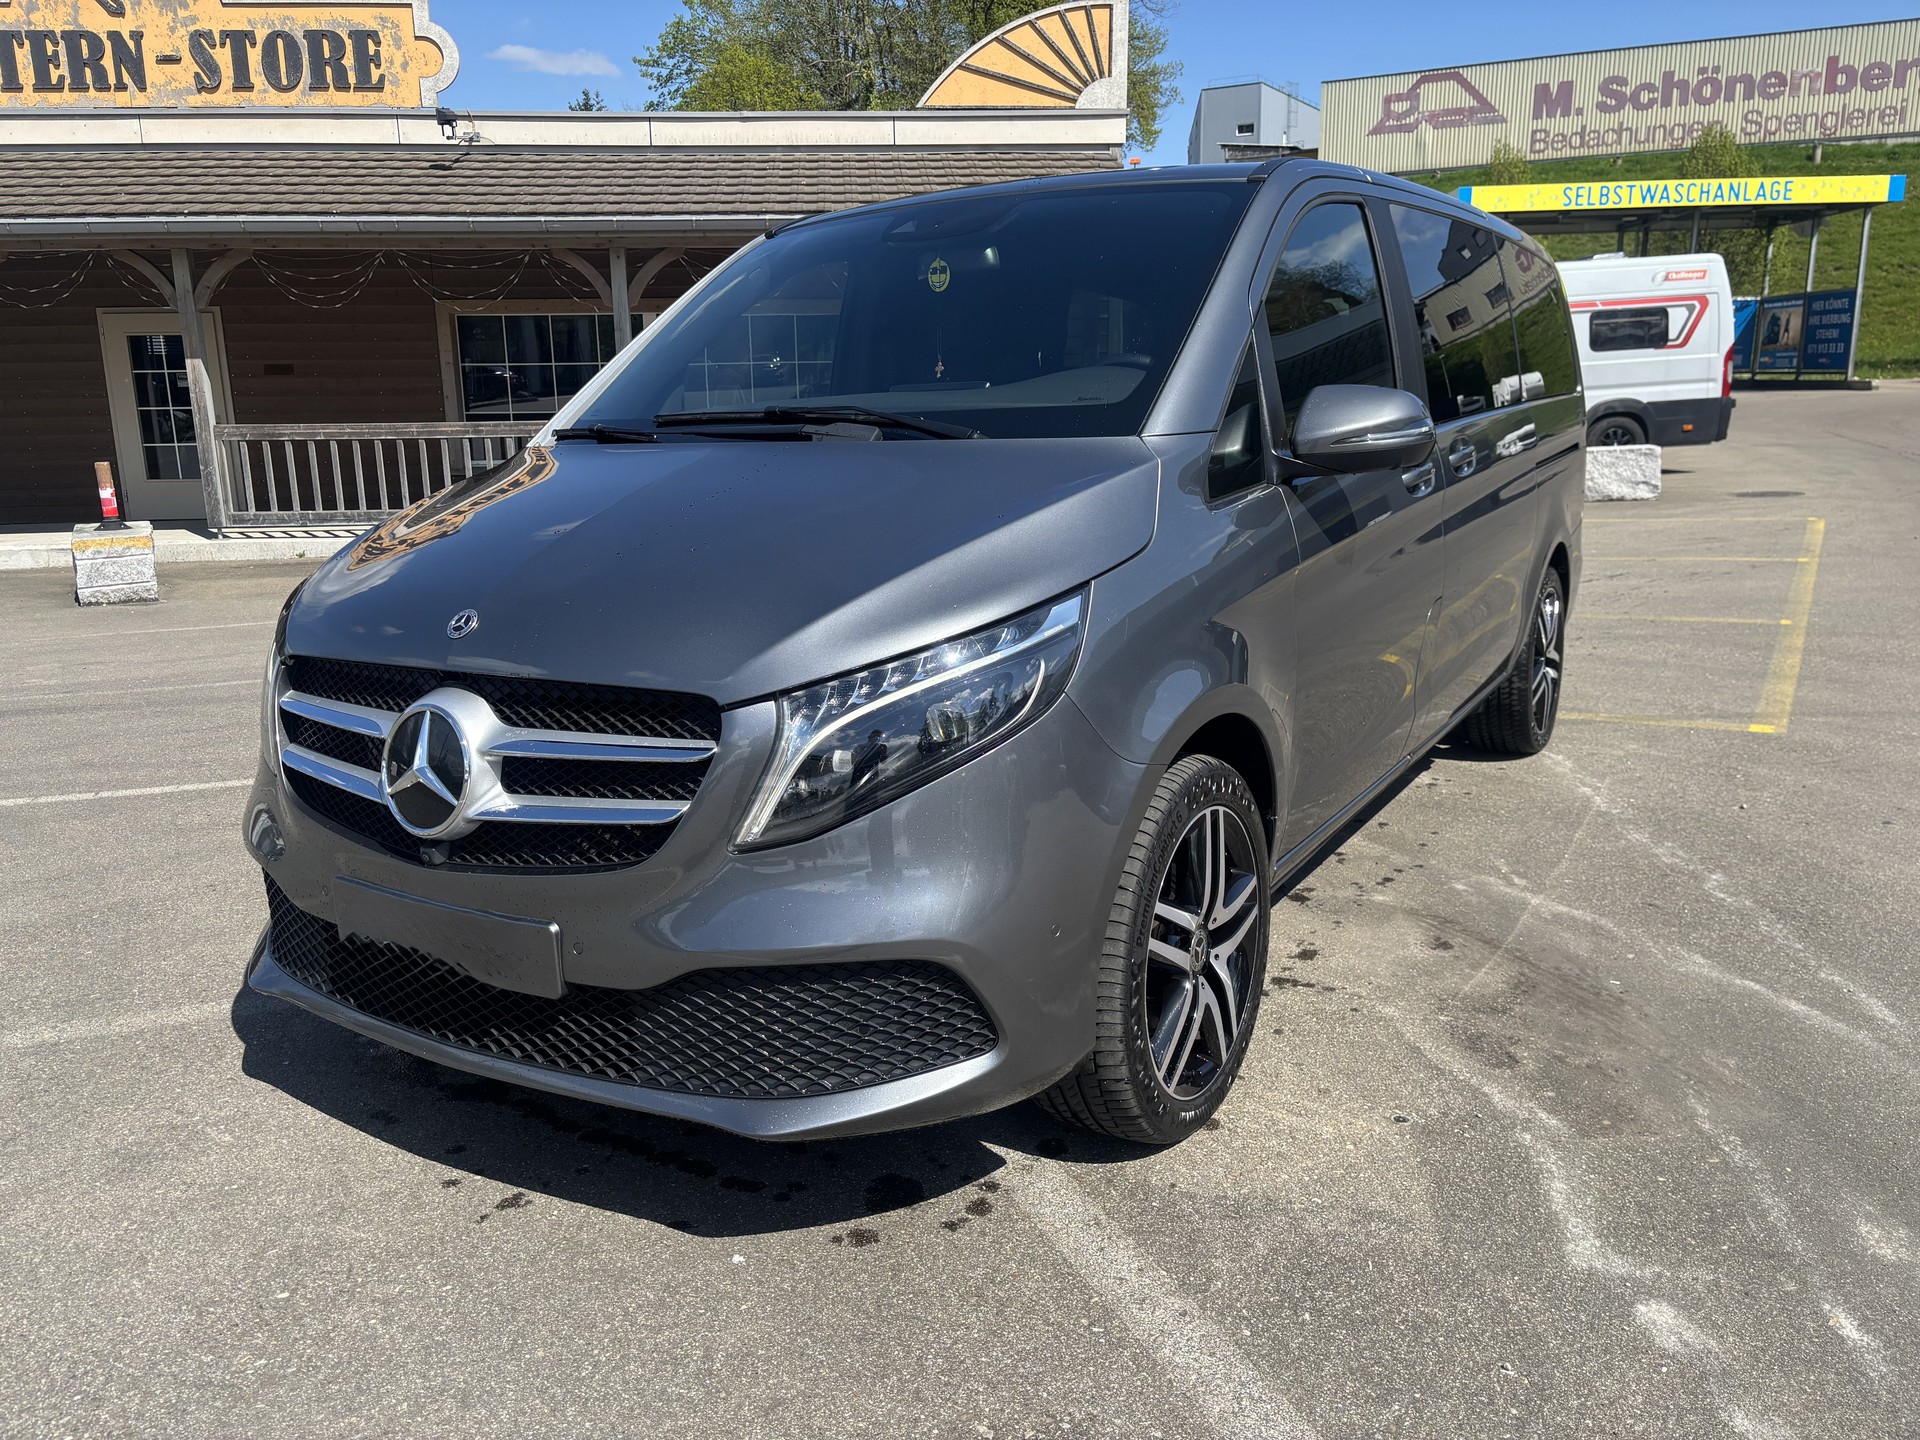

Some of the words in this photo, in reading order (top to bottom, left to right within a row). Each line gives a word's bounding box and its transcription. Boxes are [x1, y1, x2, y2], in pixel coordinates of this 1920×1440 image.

[1533, 80, 1584, 120] M.
[1742, 98, 1907, 141] Spenglerei
[1562, 181, 1794, 207] SELBSTWASCHANLAGE
[1668, 272, 1704, 280] Challenger
[1812, 300, 1825, 311] HIER
[1825, 297, 1849, 310] KÖNNTE
[1808, 315, 1821, 325] IHRE
[1821, 313, 1851, 324] WERBUNG
[1137, 820, 1180, 947] PremiumContact
